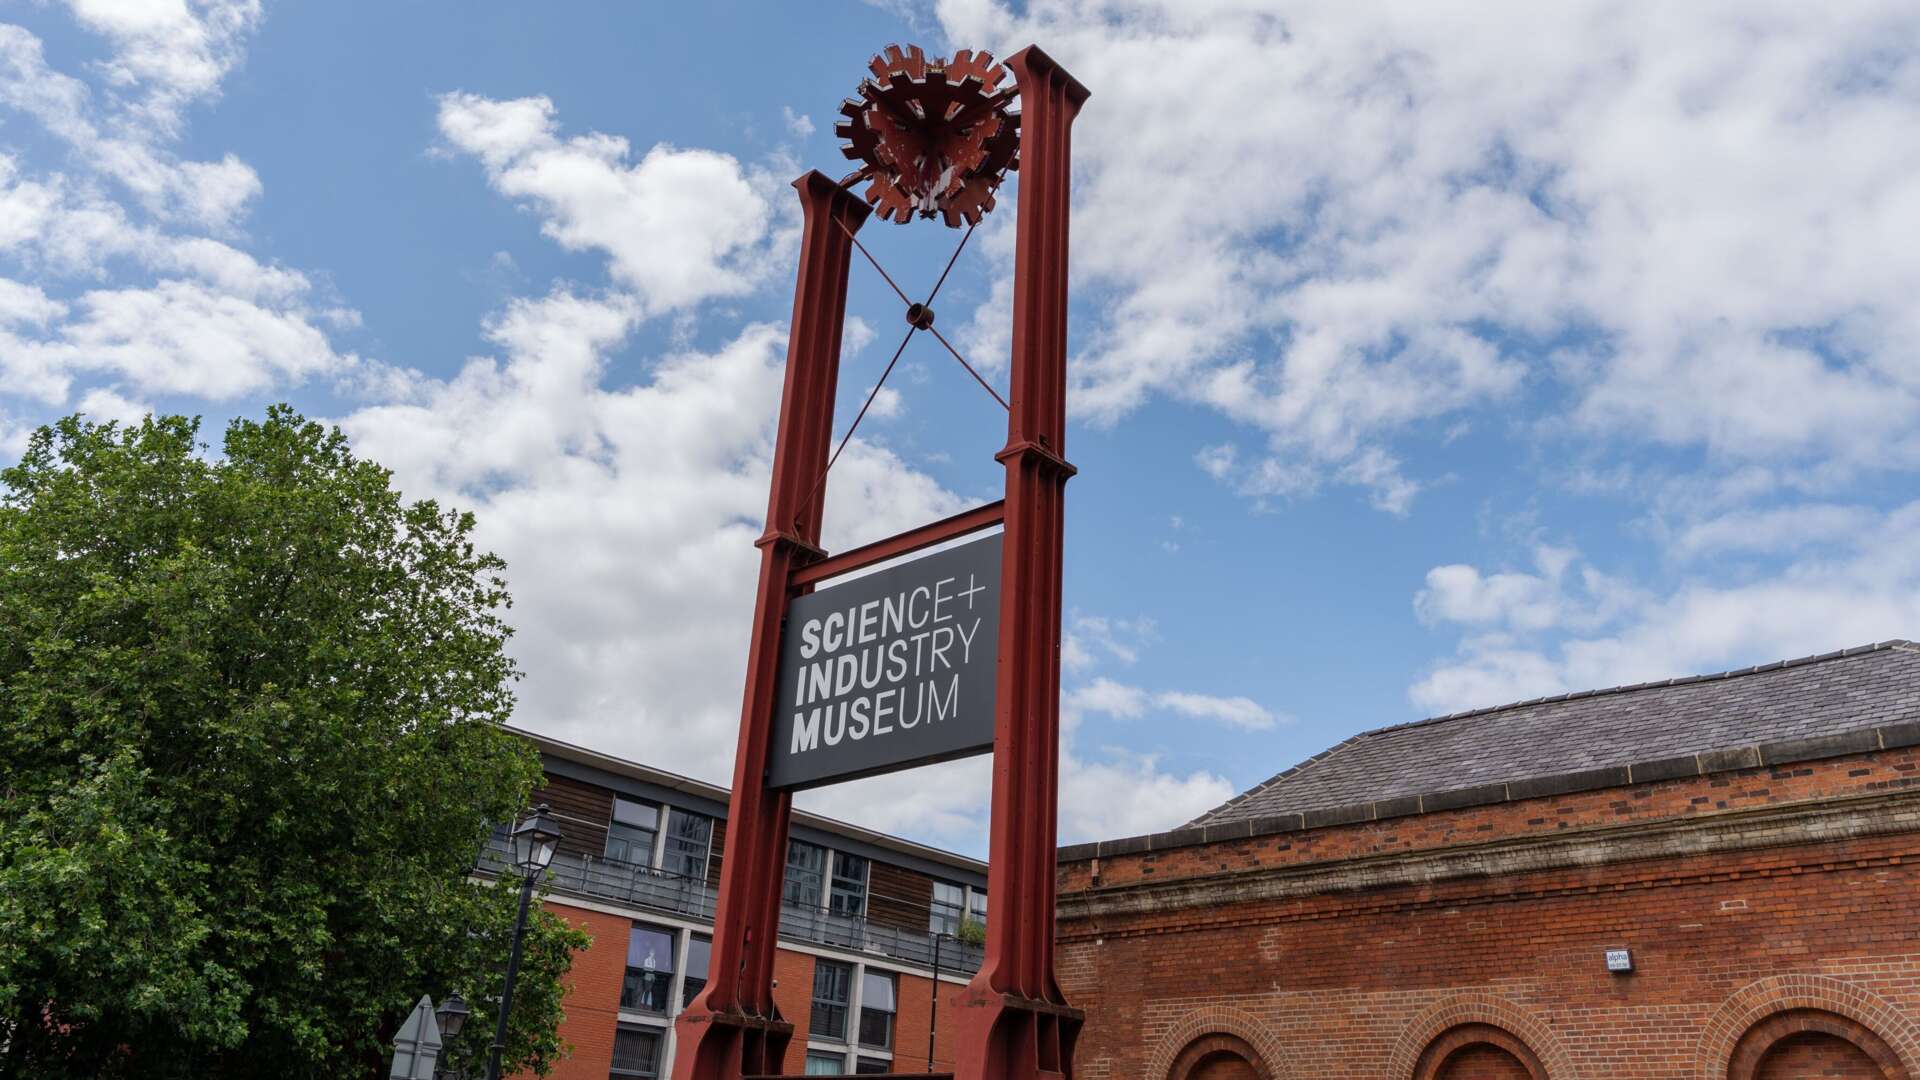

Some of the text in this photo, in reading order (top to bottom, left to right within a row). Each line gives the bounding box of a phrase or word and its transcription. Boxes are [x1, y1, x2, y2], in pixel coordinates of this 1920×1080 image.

[800, 573, 986, 659] SCIENCE+
[795, 618, 981, 707] INDUSTRY
[790, 673, 959, 754] MUSEUM
